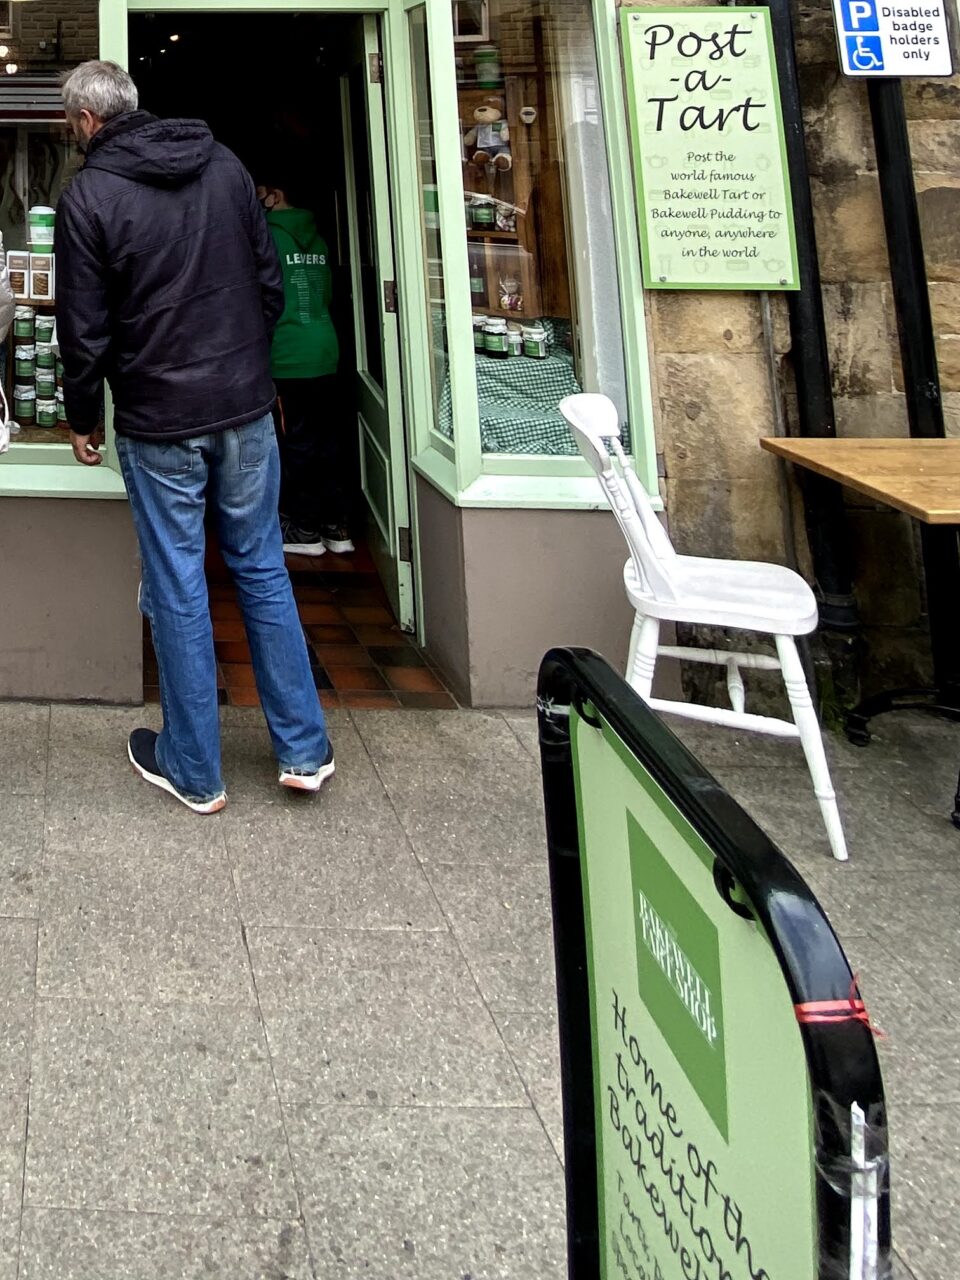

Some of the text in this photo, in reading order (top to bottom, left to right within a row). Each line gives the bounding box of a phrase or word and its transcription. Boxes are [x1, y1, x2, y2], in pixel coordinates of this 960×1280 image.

[882, 7, 940, 17] Disabled
[892, 21, 933, 32] badge
[644, 24, 752, 60] Post
[890, 35, 939, 45] holders
[903, 49, 930, 61] only
[669, 70, 732, 92] -a-
[647, 94, 766, 131] Tart
[687, 151, 736, 162] Post the
[671, 170, 756, 182] world famous
[663, 189, 720, 199] Bakewell
[722, 189, 750, 199] Tart
[651, 208, 782, 222] Bakewell Pudding to
[660, 227, 778, 240] anyone, anywhere
[681, 246, 760, 257] in the world
[612, 987, 773, 1280] Home of th
[608, 1085, 708, 1280] Bakewel
